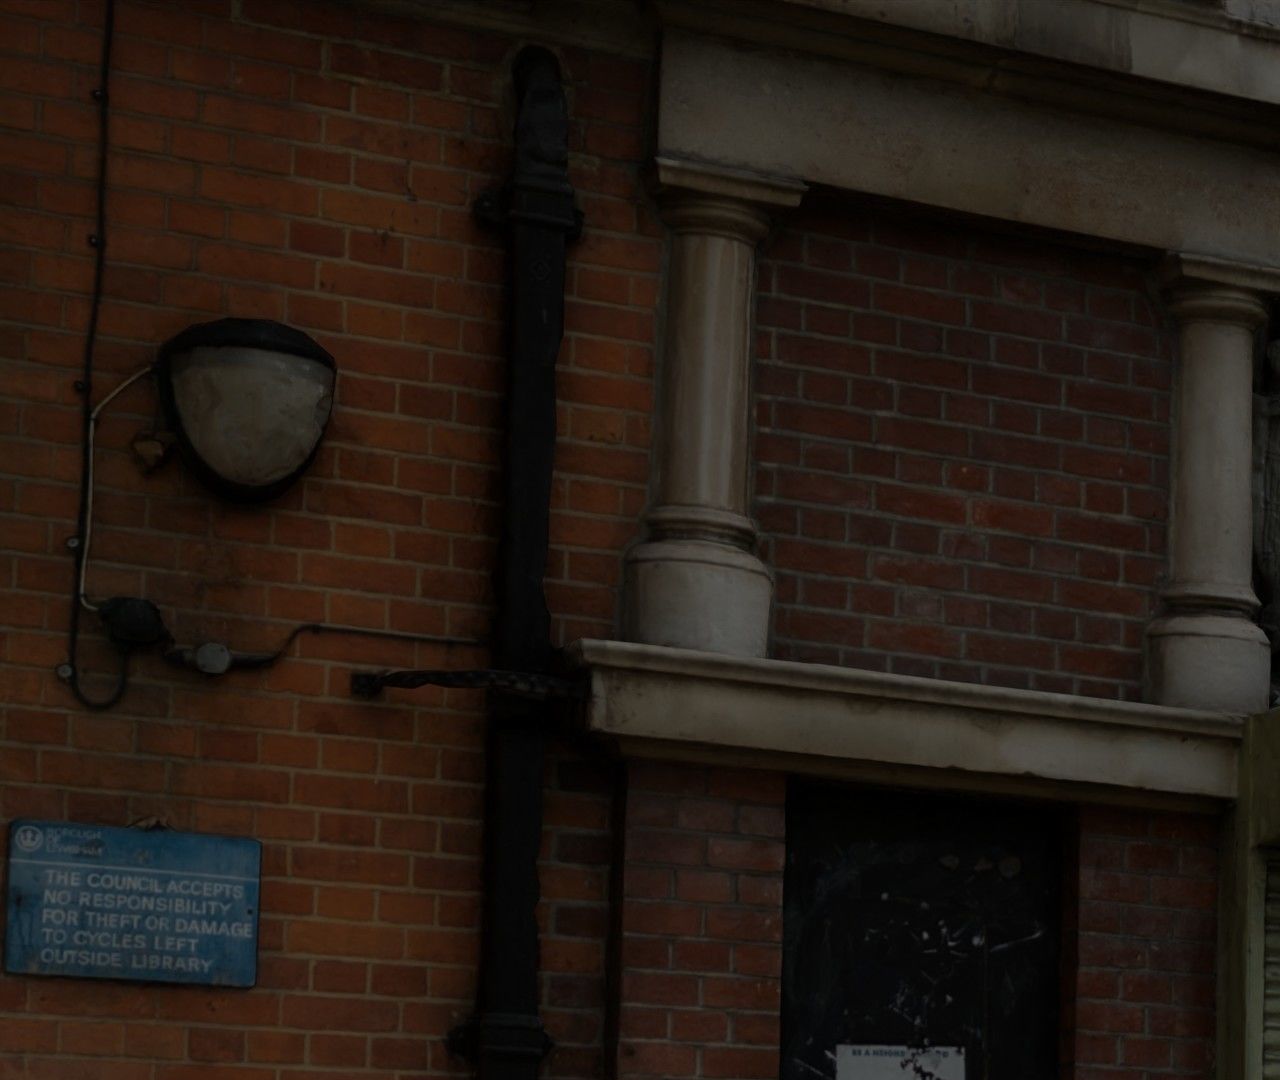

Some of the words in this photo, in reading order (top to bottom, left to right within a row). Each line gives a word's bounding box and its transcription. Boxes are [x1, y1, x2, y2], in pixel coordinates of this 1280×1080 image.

[45, 870, 81, 886] THE
[87, 873, 162, 893] COUNCIL
[166, 880, 244, 899] ACCEPTS
[44, 889, 71, 905] NO
[79, 892, 231, 916] RESPONSIBILITY
[42, 908, 78, 926] FOR
[86, 911, 141, 929] THEFT
[145, 915, 169, 930] OR
[175, 918, 253, 938] DAMAGE
[42, 928, 66, 944] TO
[73, 930, 146, 949] CYCLES
[154, 936, 199, 953] LEFT
[40, 948, 121, 967] OUTSIDE
[131, 953, 213, 973] LIBRARY
